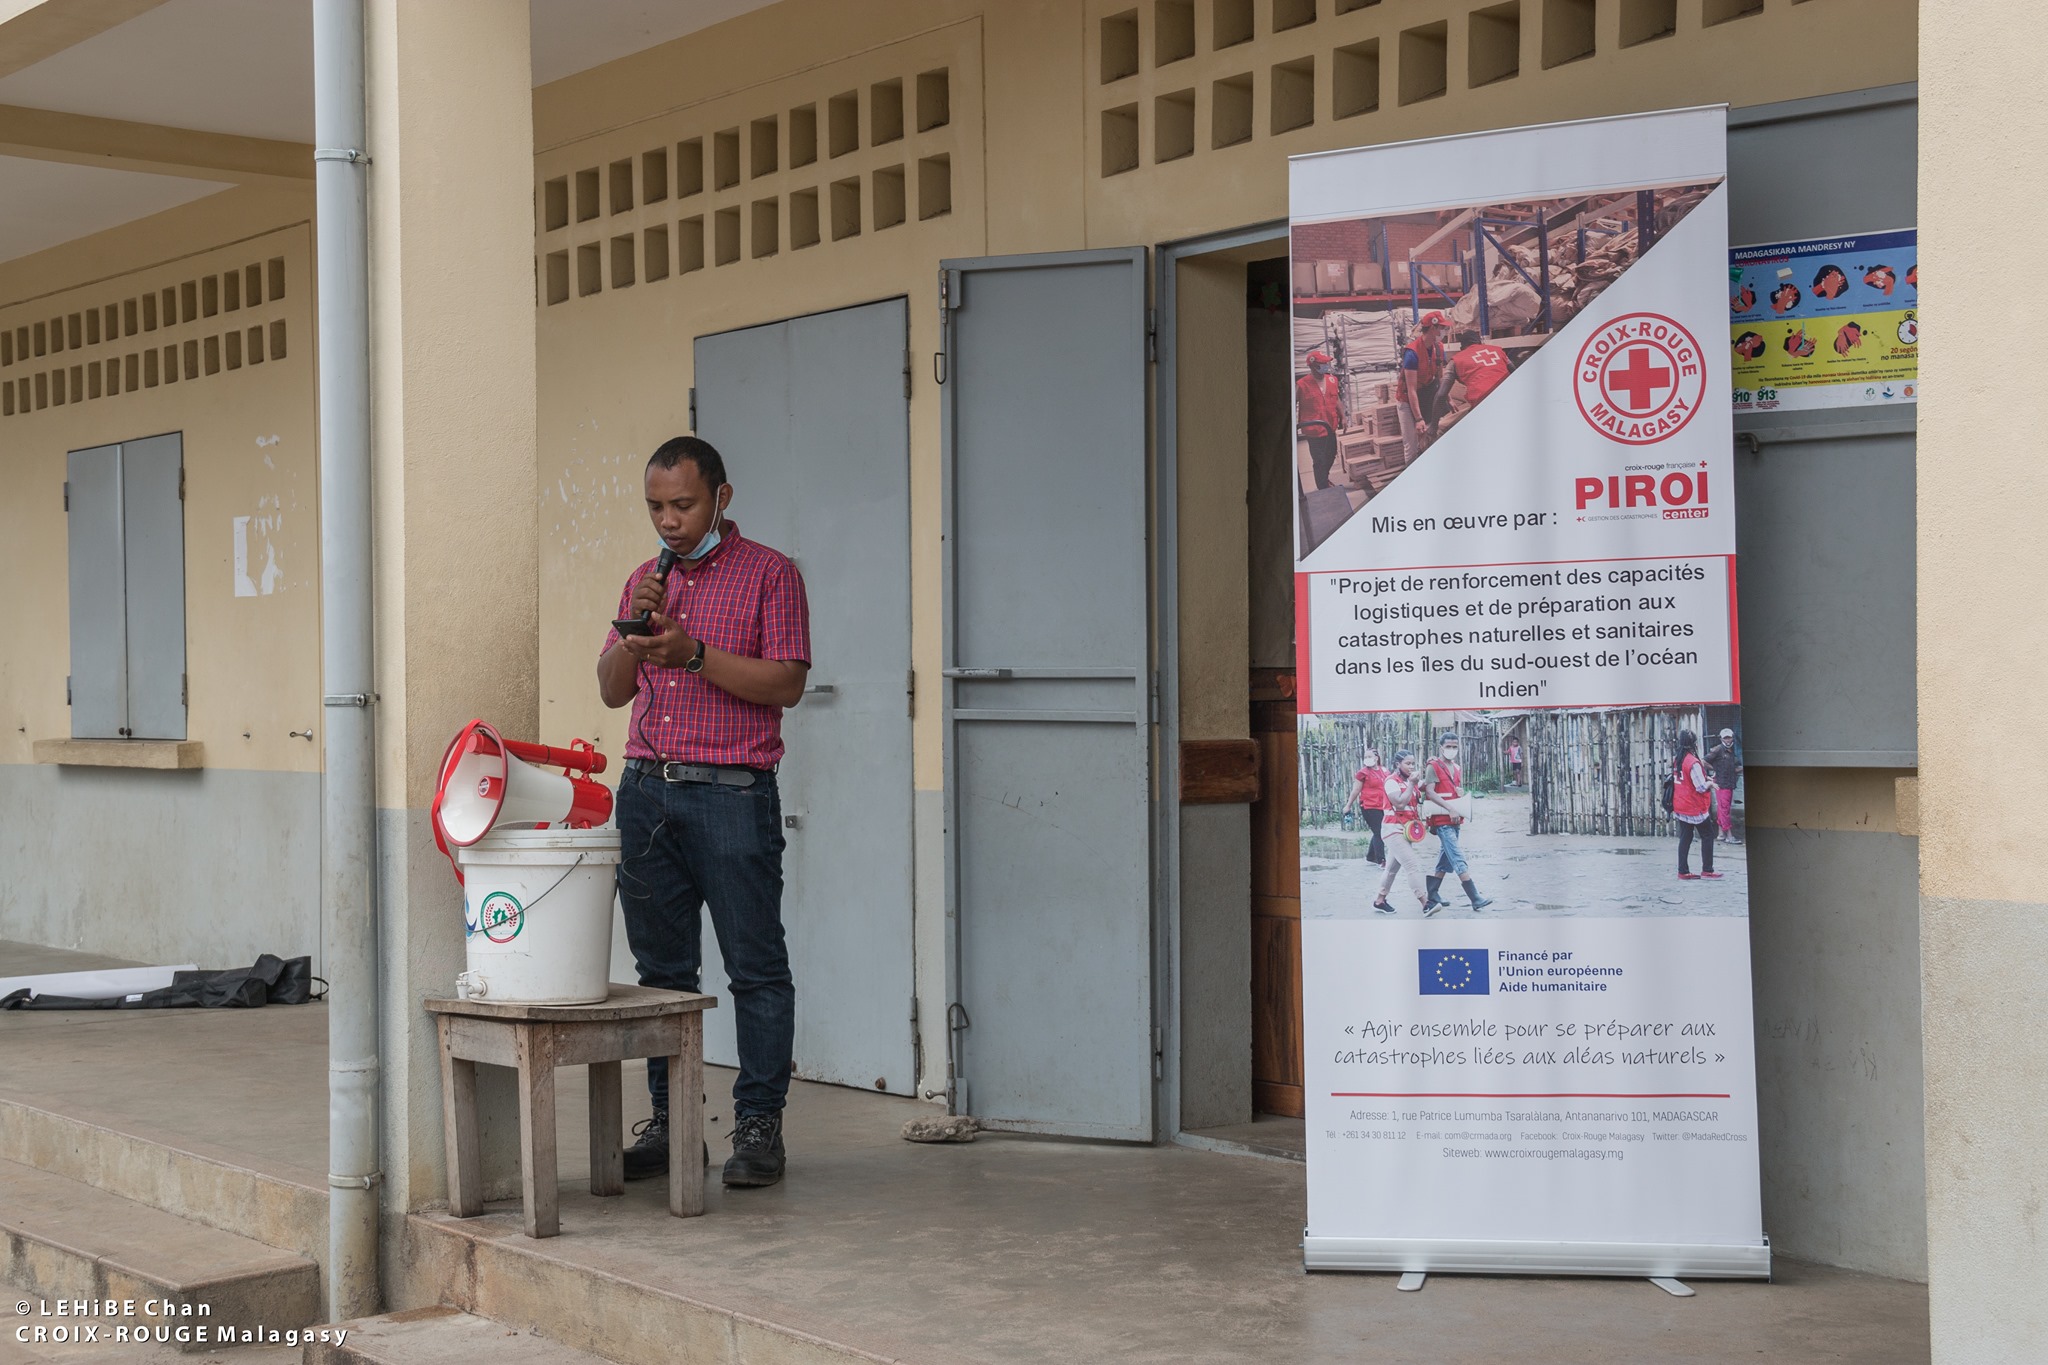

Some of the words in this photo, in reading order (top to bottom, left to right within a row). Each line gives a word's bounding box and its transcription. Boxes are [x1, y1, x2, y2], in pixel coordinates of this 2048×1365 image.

[1735, 247, 1797, 260] MADAGASIKARA
[1798, 242, 1842, 253] MANDRESY
[1844, 241, 1856, 249] NY
[1583, 322, 1697, 383] CROIX-ROUGE
[1757, 389, 1776, 401] 913
[1590, 397, 1689, 438] MALAGASY
[1625, 463, 1665, 471] croix-rouge
[1666, 461, 1696, 469] française
[1575, 471, 1709, 510] PIROI
[1373, 516, 1407, 533] Mis
[1413, 518, 1435, 531] en
[1443, 515, 1507, 529] œuvre
[1514, 513, 1546, 530] par
[1664, 508, 1708, 520] center
[1331, 577, 1396, 596] "Projet
[1401, 576, 1423, 591] de
[1430, 570, 1561, 590] renforcement
[1567, 569, 1601, 585] des
[1608, 564, 1704, 586] capacités
[1355, 603, 1459, 623] logistiques
[1466, 601, 1483, 616] et
[1489, 599, 1512, 615] de
[1518, 595, 1631, 618] préparation
[1639, 597, 1675, 610] aux
[1339, 629, 1463, 649] catastrophes
[1469, 625, 1565, 643] naturelles
[1572, 624, 1590, 640] et
[1596, 621, 1693, 639] sanitaires
[1336, 659, 1381, 674] dans
[1388, 658, 1414, 673] les
[1421, 656, 1454, 672] îles
[1461, 655, 1483, 671] du
[1491, 652, 1590, 670] sud-ouest
[1596, 651, 1619, 667] de
[1626, 648, 1697, 665] l’océan
[1480, 680, 1546, 697] Indien"
[1499, 950, 1548, 961] Financé
[1553, 952, 1572, 962] par
[1499, 966, 1543, 976] l’Union
[1548, 965, 1623, 978] européenne
[1499, 982, 1527, 992] Aide
[1532, 982, 1607, 991] humanitaire
[1345, 1026, 1354, 1034] «
[1362, 1020, 1402, 1043] Agir
[1410, 1019, 1497, 1037] ensemble
[1505, 1024, 1548, 1040] pour
[1556, 1024, 1576, 1036] se
[1585, 1020, 1673, 1040] préparer
[1681, 1023, 1715, 1036] aux
[1335, 1047, 1466, 1068] catastrophes
[1475, 1047, 1515, 1065] liées
[1523, 1051, 1556, 1064] aux
[1563, 1047, 1614, 1064] aléas
[1622, 1046, 1706, 1064] naturels
[1715, 1054, 1725, 1062] »
[1350, 1110, 1389, 1121] Adresse:
[1392, 1110, 1399, 1122] 1,
[1402, 1112, 1417, 1121] rue
[1420, 1110, 1451, 1121] Patrice
[1454, 1111, 1502, 1121] Lumumba
[1565, 1111, 1628, 1122] Antananarivo
[1631, 1111, 1649, 1123] 101,
[1653, 1111, 1718, 1122] MADAGASCAR
[1342, 1130, 1359, 1139] +261
[1361, 1131, 1370, 1139] 34
[1372, 1131, 1381, 1139] 30
[1383, 1131, 1395, 1140] 811
[1397, 1131, 1406, 1140] 12
[1444, 1131, 1512, 1141] com@crmada.org
[1562, 1132, 1607, 1141] Croix-Rouge
[1609, 1132, 1645, 1142] Malagasy
[1682, 1132, 1747, 1142] @MadaRedCross
[1443, 1147, 1482, 1158] Siteweb:
[1485, 1148, 1624, 1160] www.croixrougemalagasy.mg
